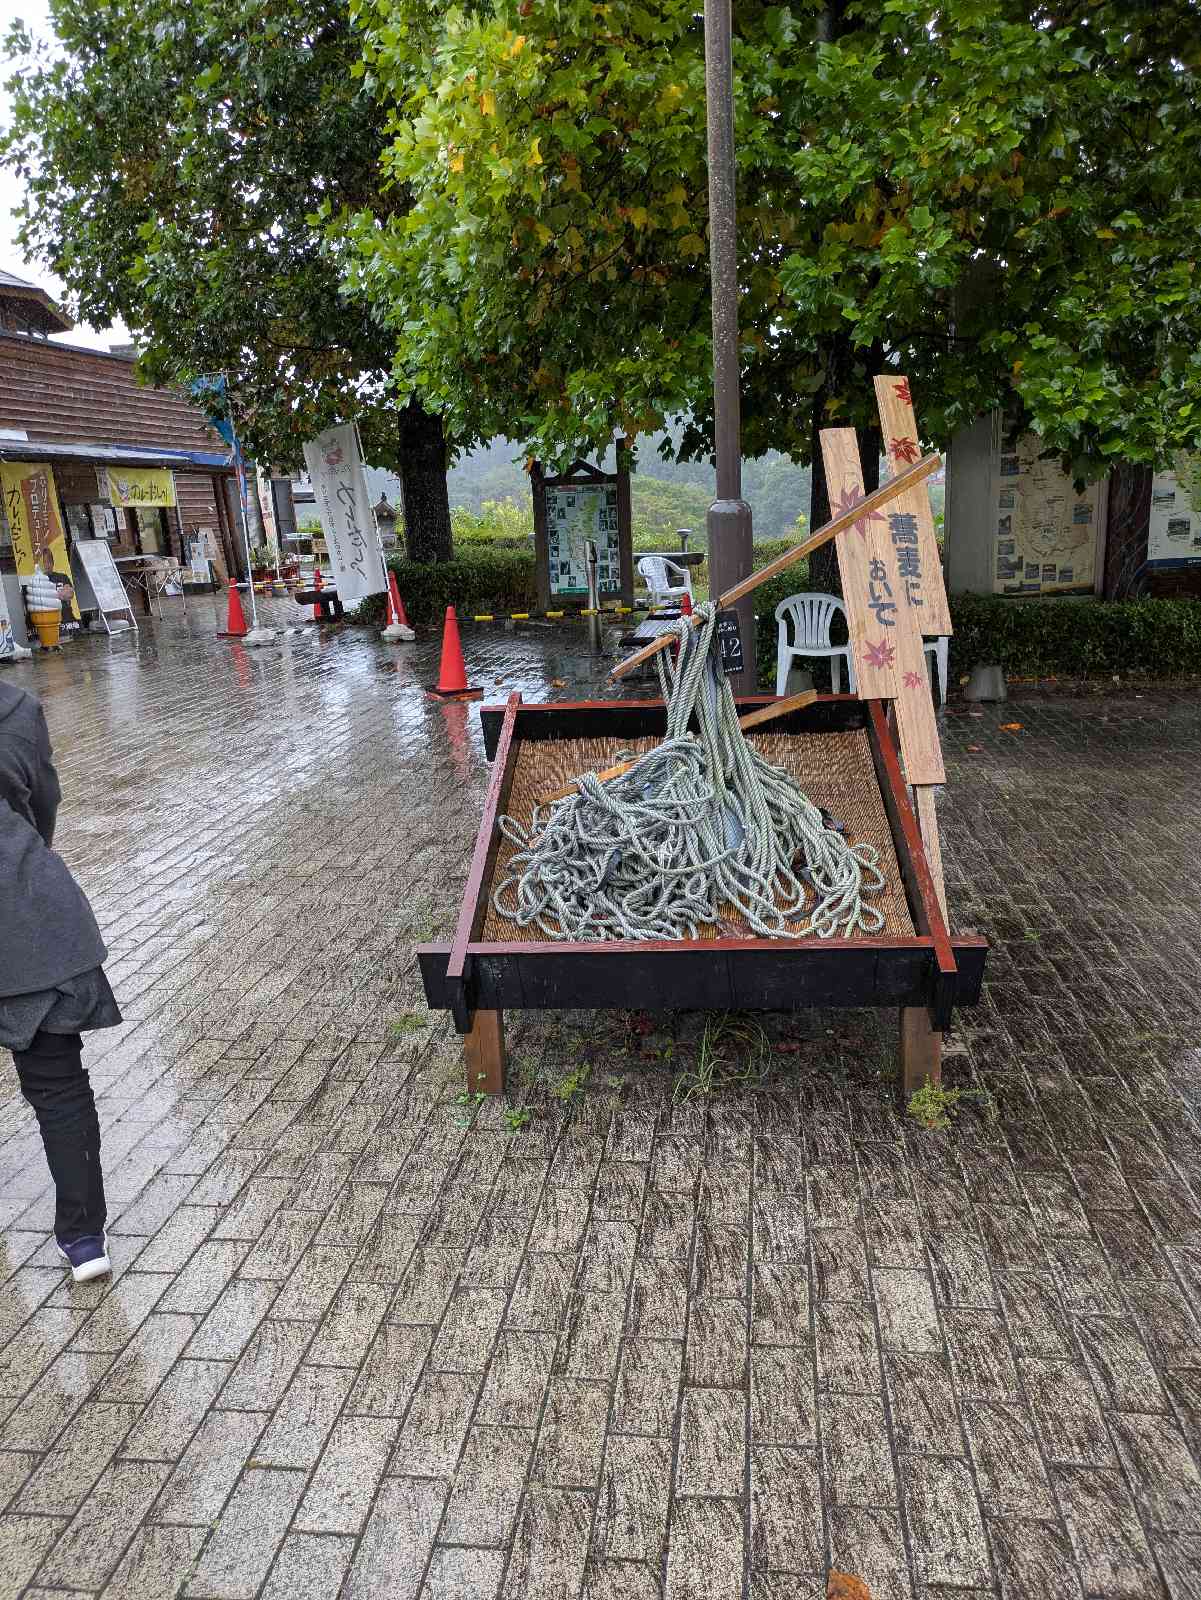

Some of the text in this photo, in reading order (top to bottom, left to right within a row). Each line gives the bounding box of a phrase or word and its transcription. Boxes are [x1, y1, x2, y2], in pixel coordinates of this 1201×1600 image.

[868, 556, 898, 626] おいで
[888, 513, 923, 607] 蕎麦に
